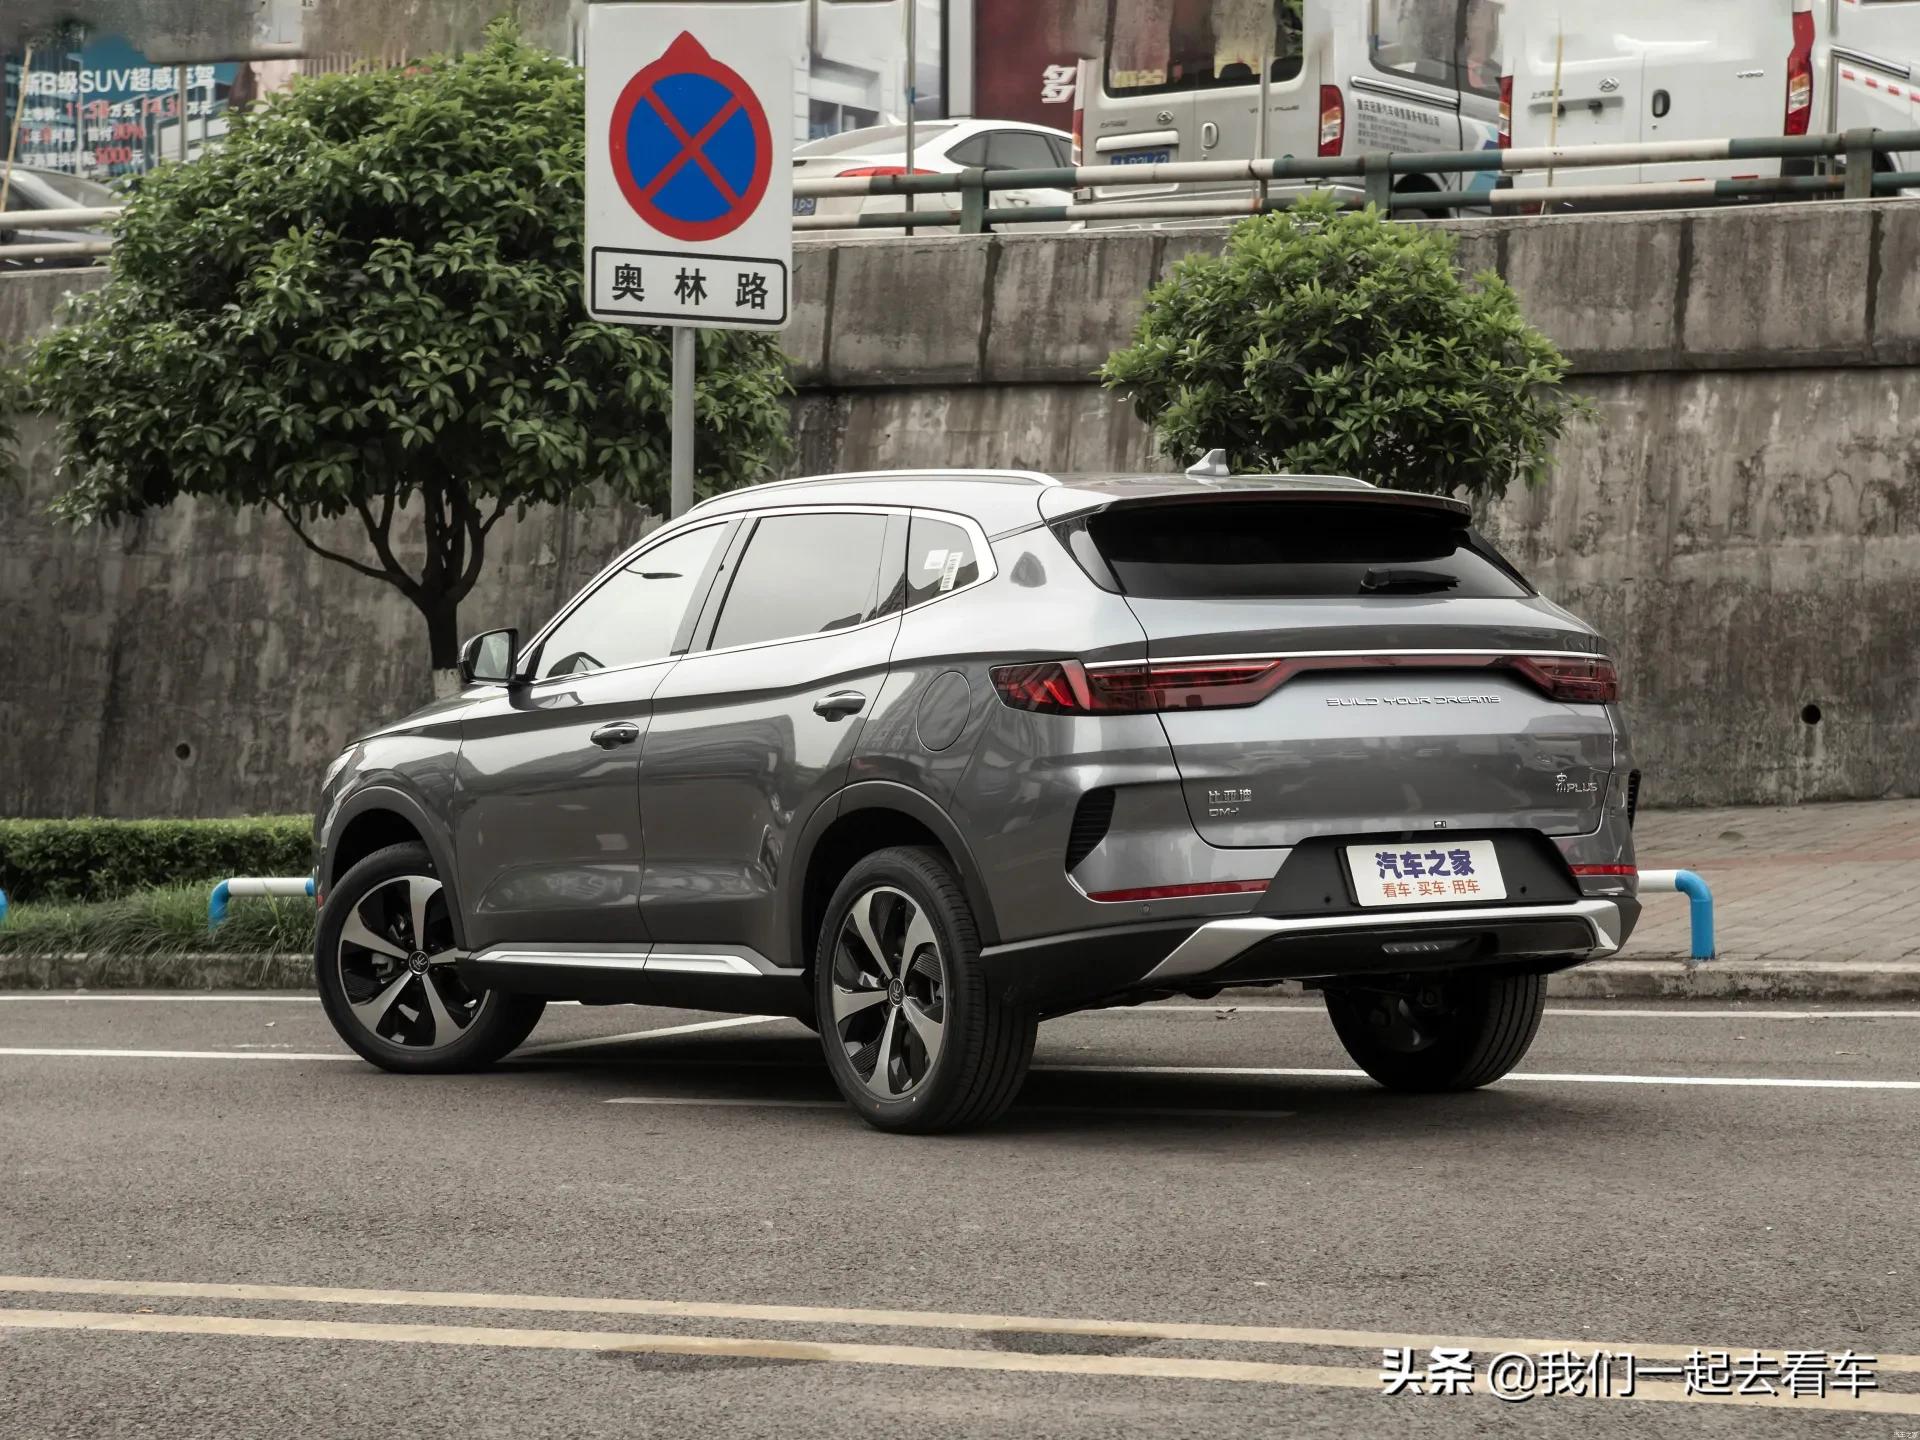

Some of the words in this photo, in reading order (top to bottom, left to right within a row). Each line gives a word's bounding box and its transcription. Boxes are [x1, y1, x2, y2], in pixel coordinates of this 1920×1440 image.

[612, 263, 768, 310] 奥林路
[1326, 697, 1379, 706] BUILD
[1383, 697, 1431, 705] YOUR
[1434, 695, 1500, 704] DREAMS
[1208, 789, 1252, 804] 比亚迪
[1375, 849, 1476, 879] 汽车之家
